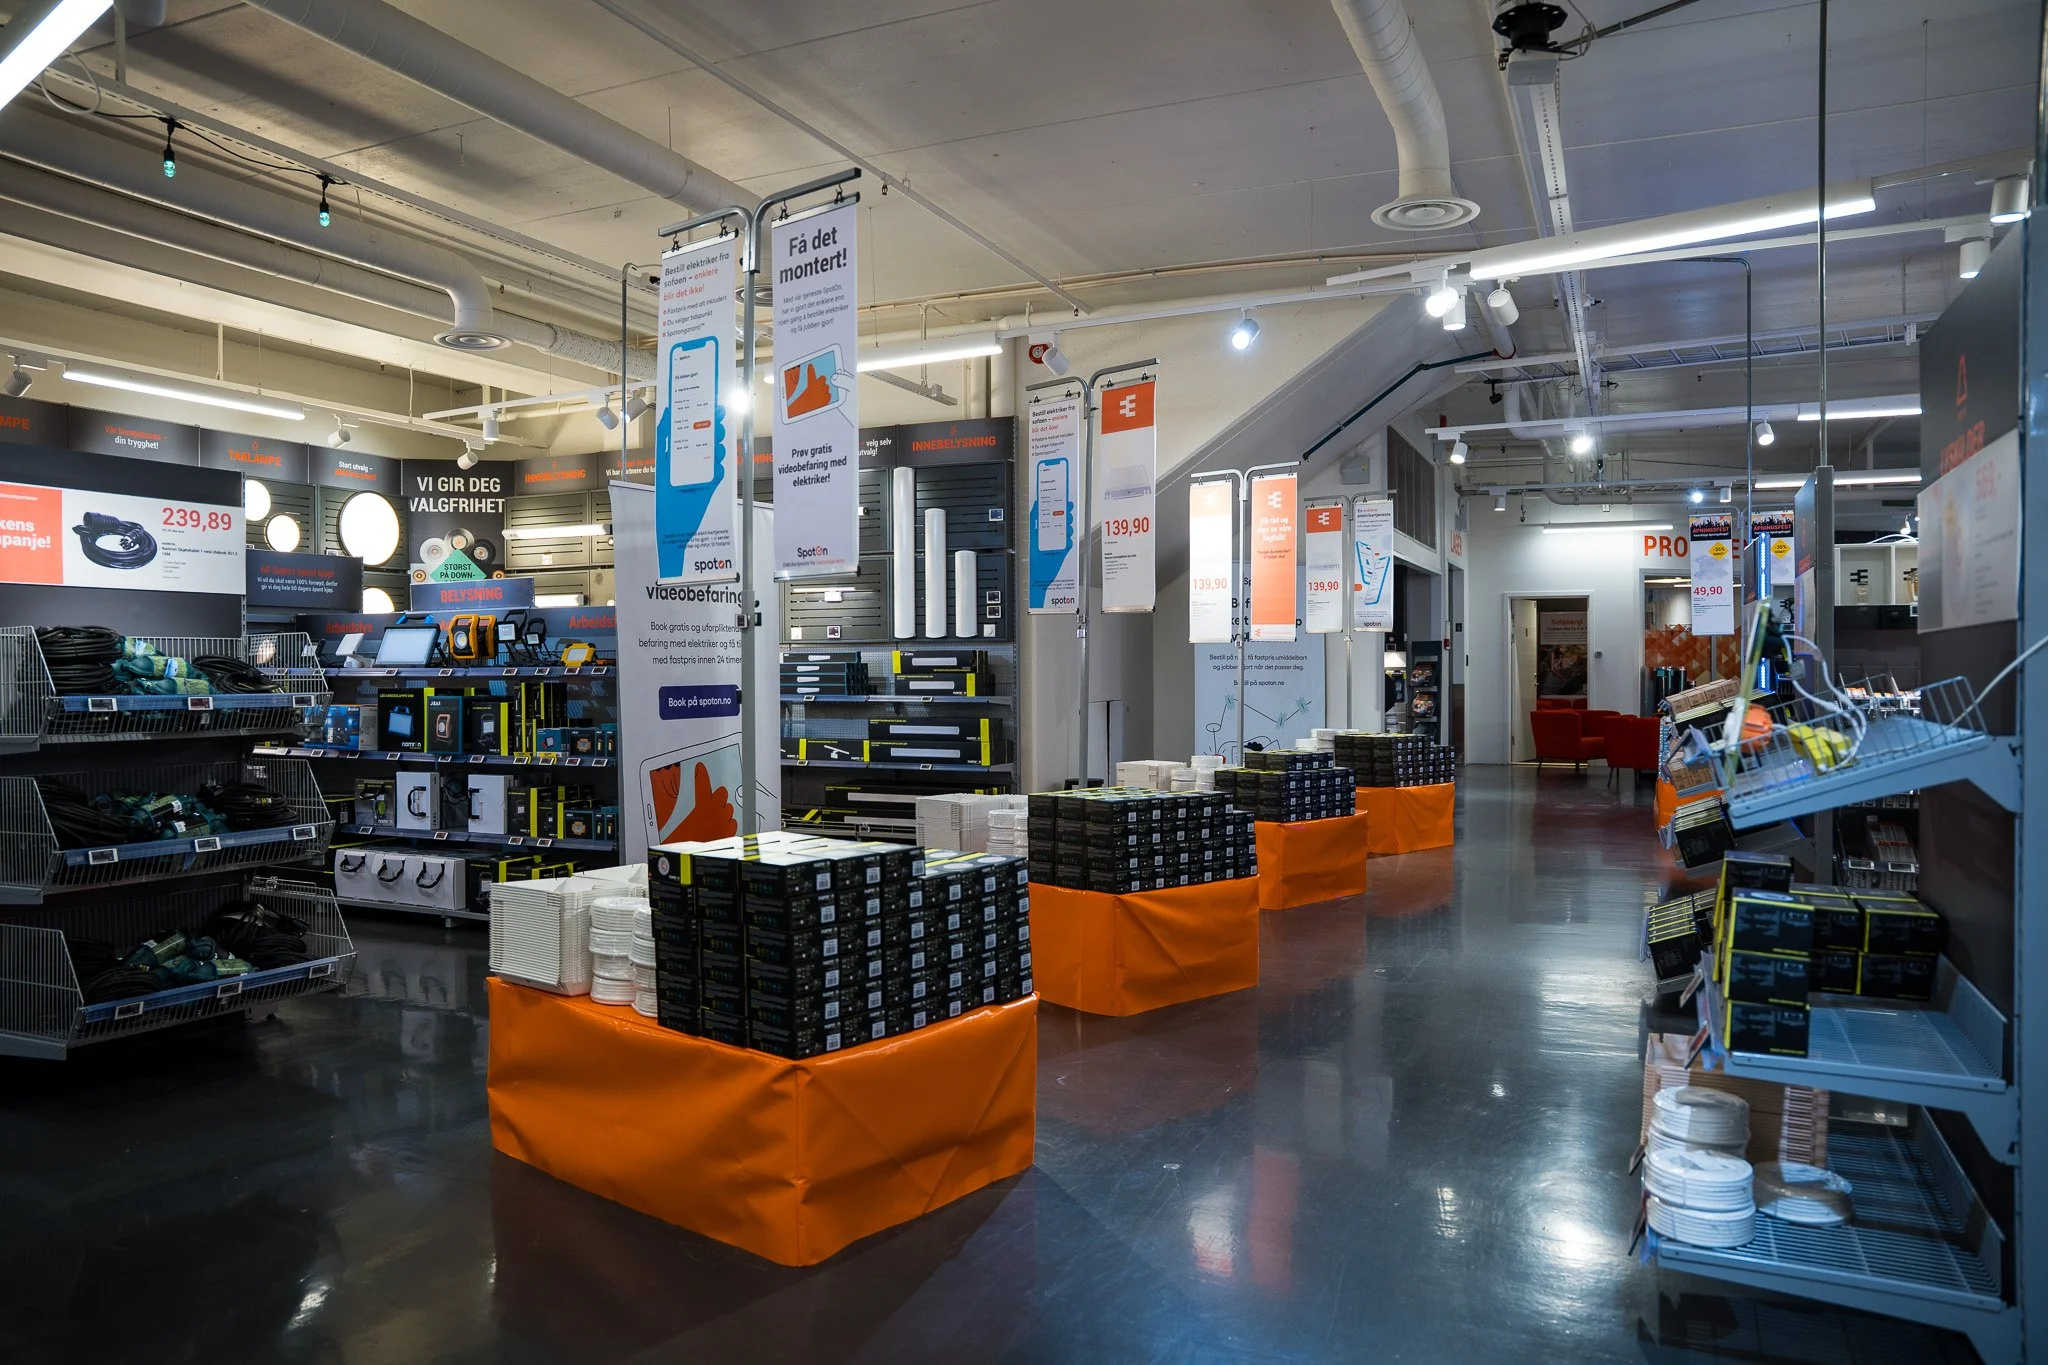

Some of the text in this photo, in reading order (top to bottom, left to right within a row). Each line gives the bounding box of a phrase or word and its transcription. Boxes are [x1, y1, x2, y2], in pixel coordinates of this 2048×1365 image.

[789, 227, 837, 257] Få det
[665, 252, 729, 276] Bestill elektriker fra
[780, 247, 847, 284] montert!
[664, 267, 719, 288] sofaen enklere
[675, 289, 687, 298] det
[115, 436, 159, 450] din trygghet!
[866, 437, 892, 448] velg selv
[912, 435, 997, 452] INNEBELYSNING
[227, 449, 282, 467] TAKLAMPE
[791, 443, 833, 459] Prøv gratis
[338, 460, 352, 469] Stort
[778, 456, 847, 474] videobefaring med
[417, 476, 500, 493] VI GIR DEG
[792, 472, 831, 487] elektriker!
[410, 497, 505, 513] VALGFRIHET
[162, 507, 232, 533] 239,89
[1105, 516, 1150, 537] 139,90
[0, 533, 52, 550] panje!
[261, 564, 271, 574] 60
[444, 562, 471, 571] STØRST
[694, 557, 732, 574] spoton
[440, 570, 476, 579] PÅ DOWN-
[1193, 577, 1227, 591] 139,90
[1308, 581, 1339, 593] 139,90
[1693, 585, 1723, 597] 49,90
[440, 586, 503, 603] BELYSNING
[1051, 596, 1075, 607] spoton
[326, 622, 373, 634] Arbeidslys
[650, 621, 668, 631] Book
[669, 622, 690, 634] gratis
[691, 624, 701, 634] og
[639, 638, 736, 650] befaring med elektriker og få
[653, 655, 668, 665] med
[669, 655, 697, 666] fastpris
[698, 656, 715, 664] innen
[717, 655, 725, 664] 24
[668, 695, 732, 708] Book på spoton.no
